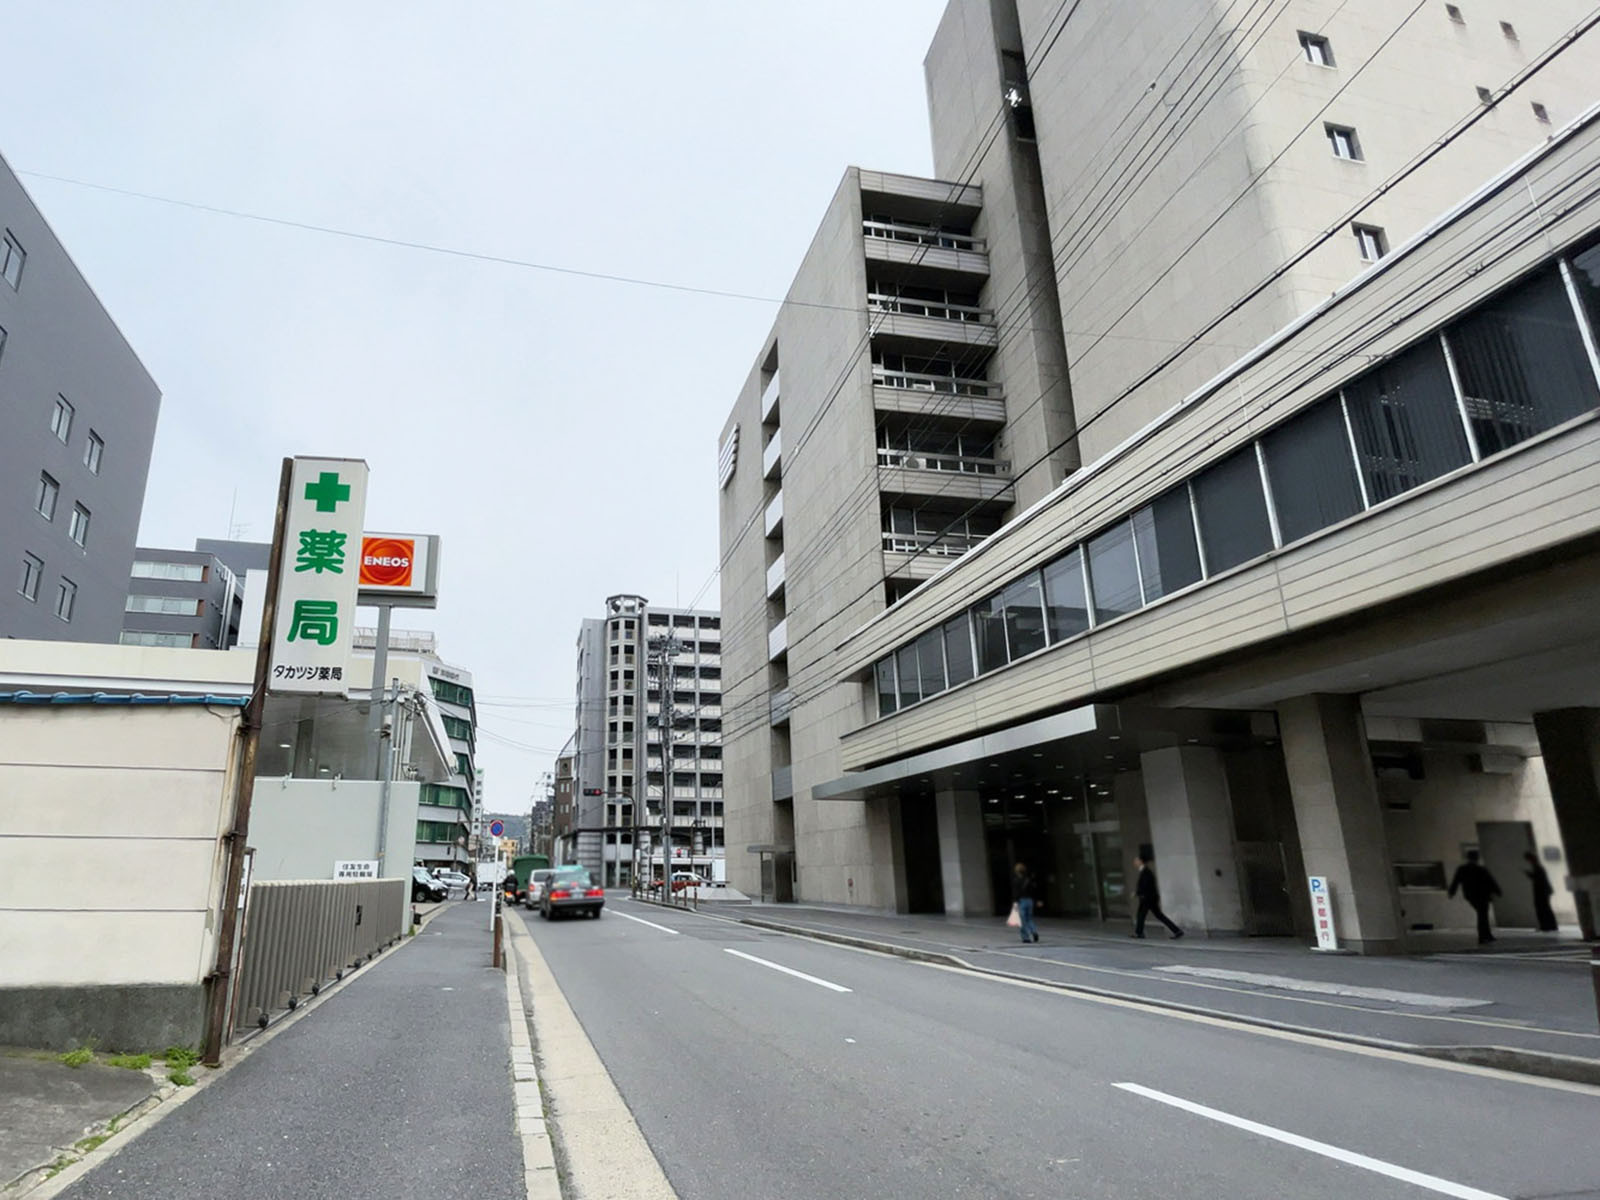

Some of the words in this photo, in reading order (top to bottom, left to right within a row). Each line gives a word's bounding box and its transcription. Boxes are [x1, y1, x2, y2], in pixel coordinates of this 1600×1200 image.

[363, 555, 410, 568] ENEOS
[287, 528, 348, 646] 薬局
[273, 664, 343, 681] タカツジ薬局
